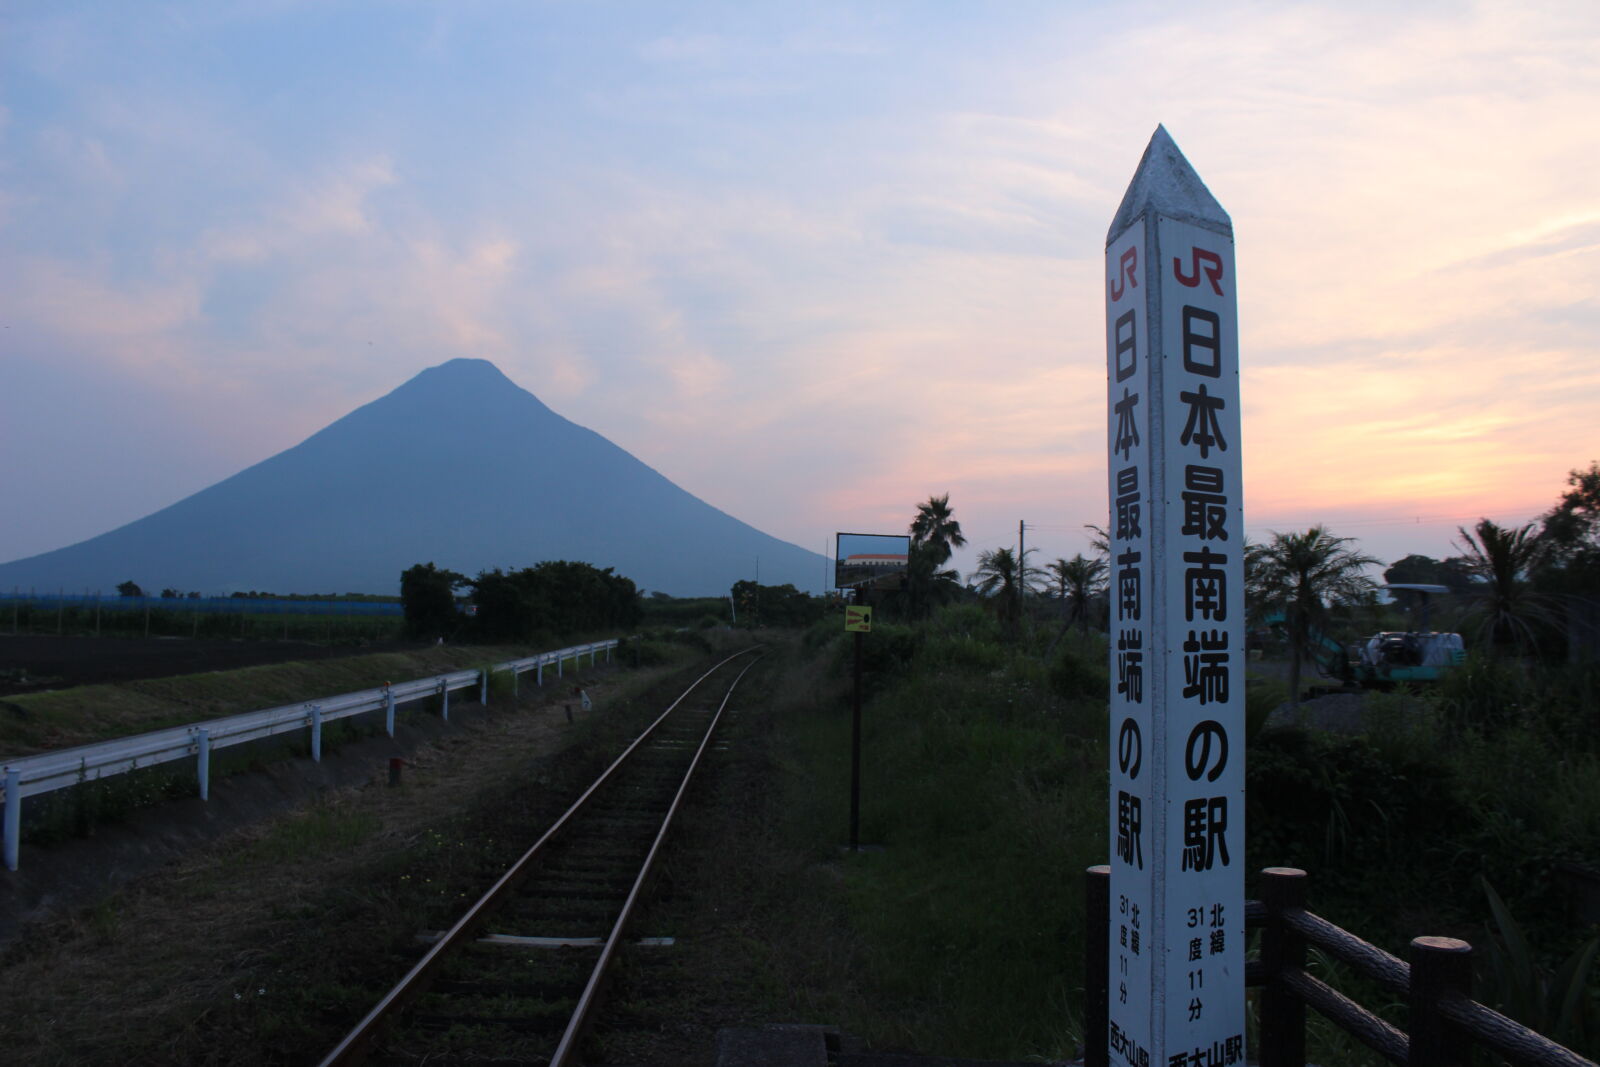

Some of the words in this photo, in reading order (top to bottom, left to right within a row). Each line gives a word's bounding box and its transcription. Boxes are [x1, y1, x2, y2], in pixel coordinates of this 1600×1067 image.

[1111, 246, 1138, 302] JR
[1173, 246, 1225, 297] JR
[1114, 308, 1143, 871] 日本最南端の駅
[1180, 304, 1231, 873] 日本最南端の駅
[1187, 906, 1204, 1022] 31度11分
[1210, 902, 1225, 956] 北緯
